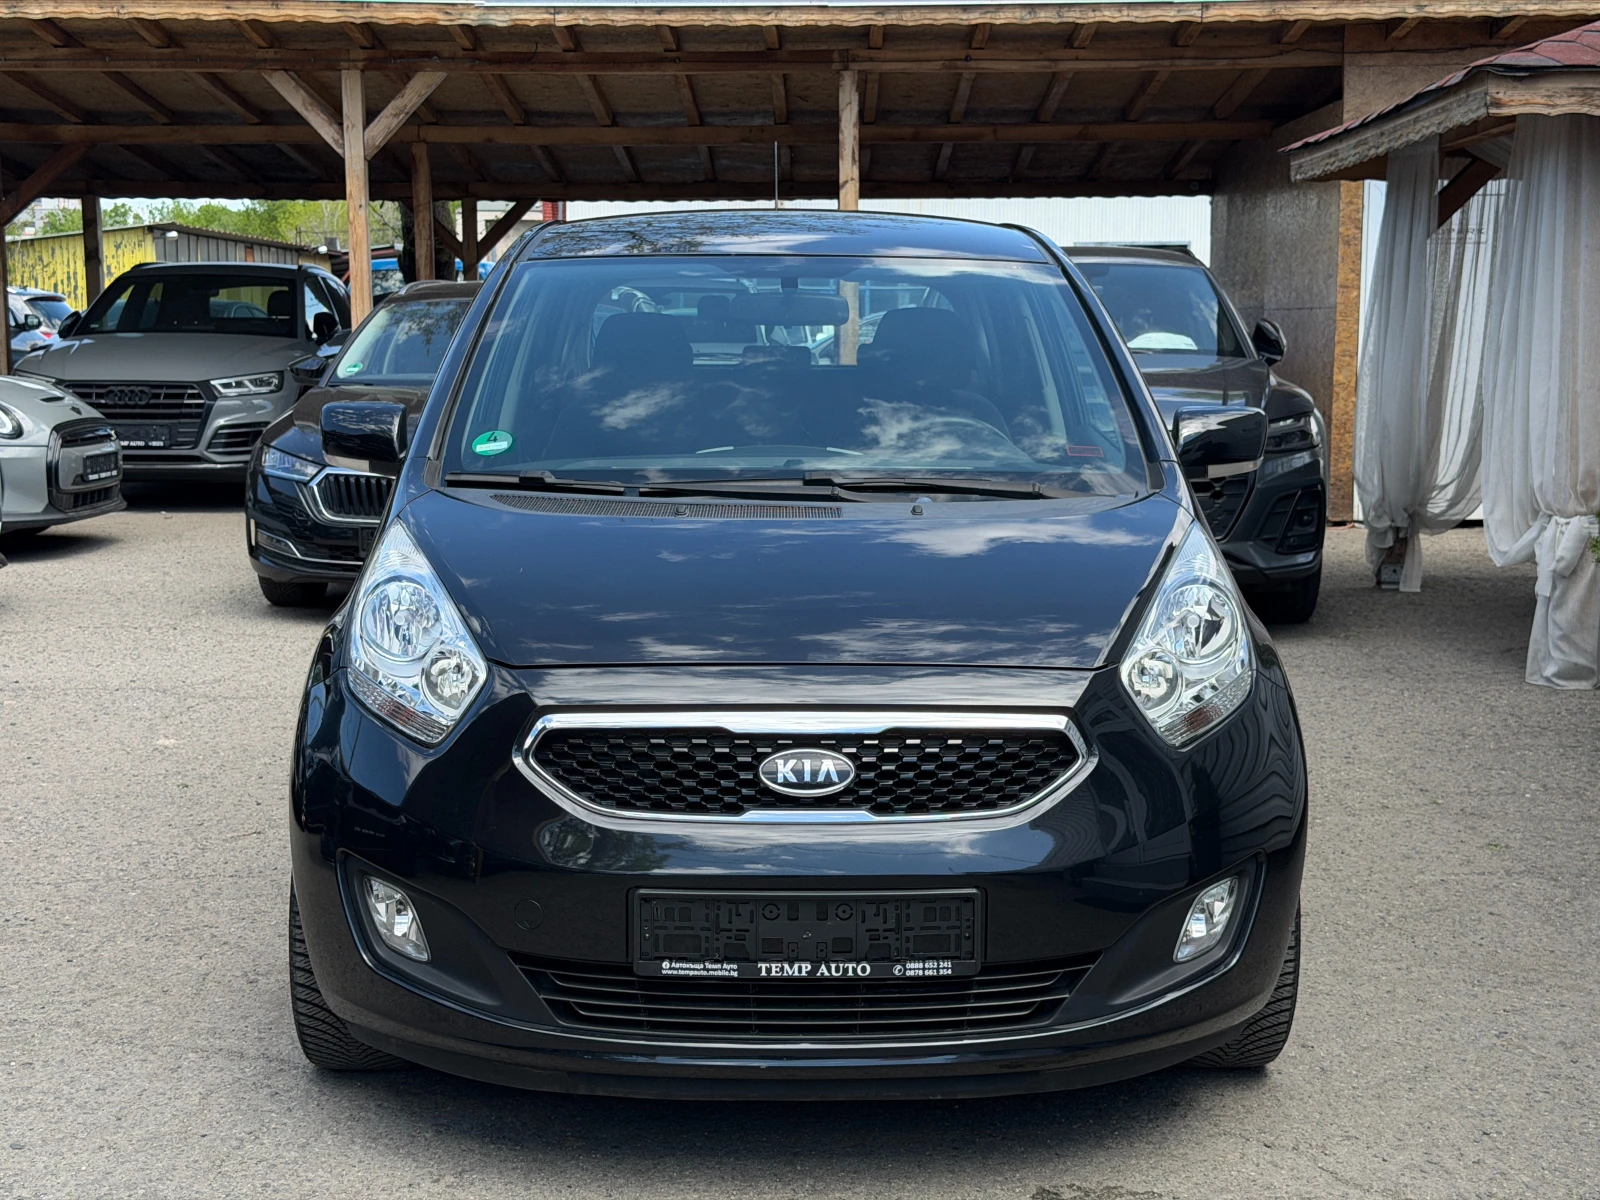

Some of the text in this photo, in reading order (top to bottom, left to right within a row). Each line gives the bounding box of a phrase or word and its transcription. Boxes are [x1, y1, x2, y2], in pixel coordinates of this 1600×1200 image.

[486, 432, 498, 442] 4
[775, 759, 839, 783] KIA
[671, 962, 704, 970] Автокъща
[758, 963, 871, 976] TEMP AUTO
[662, 969, 738, 977] www.tempauto.mobile.bg
